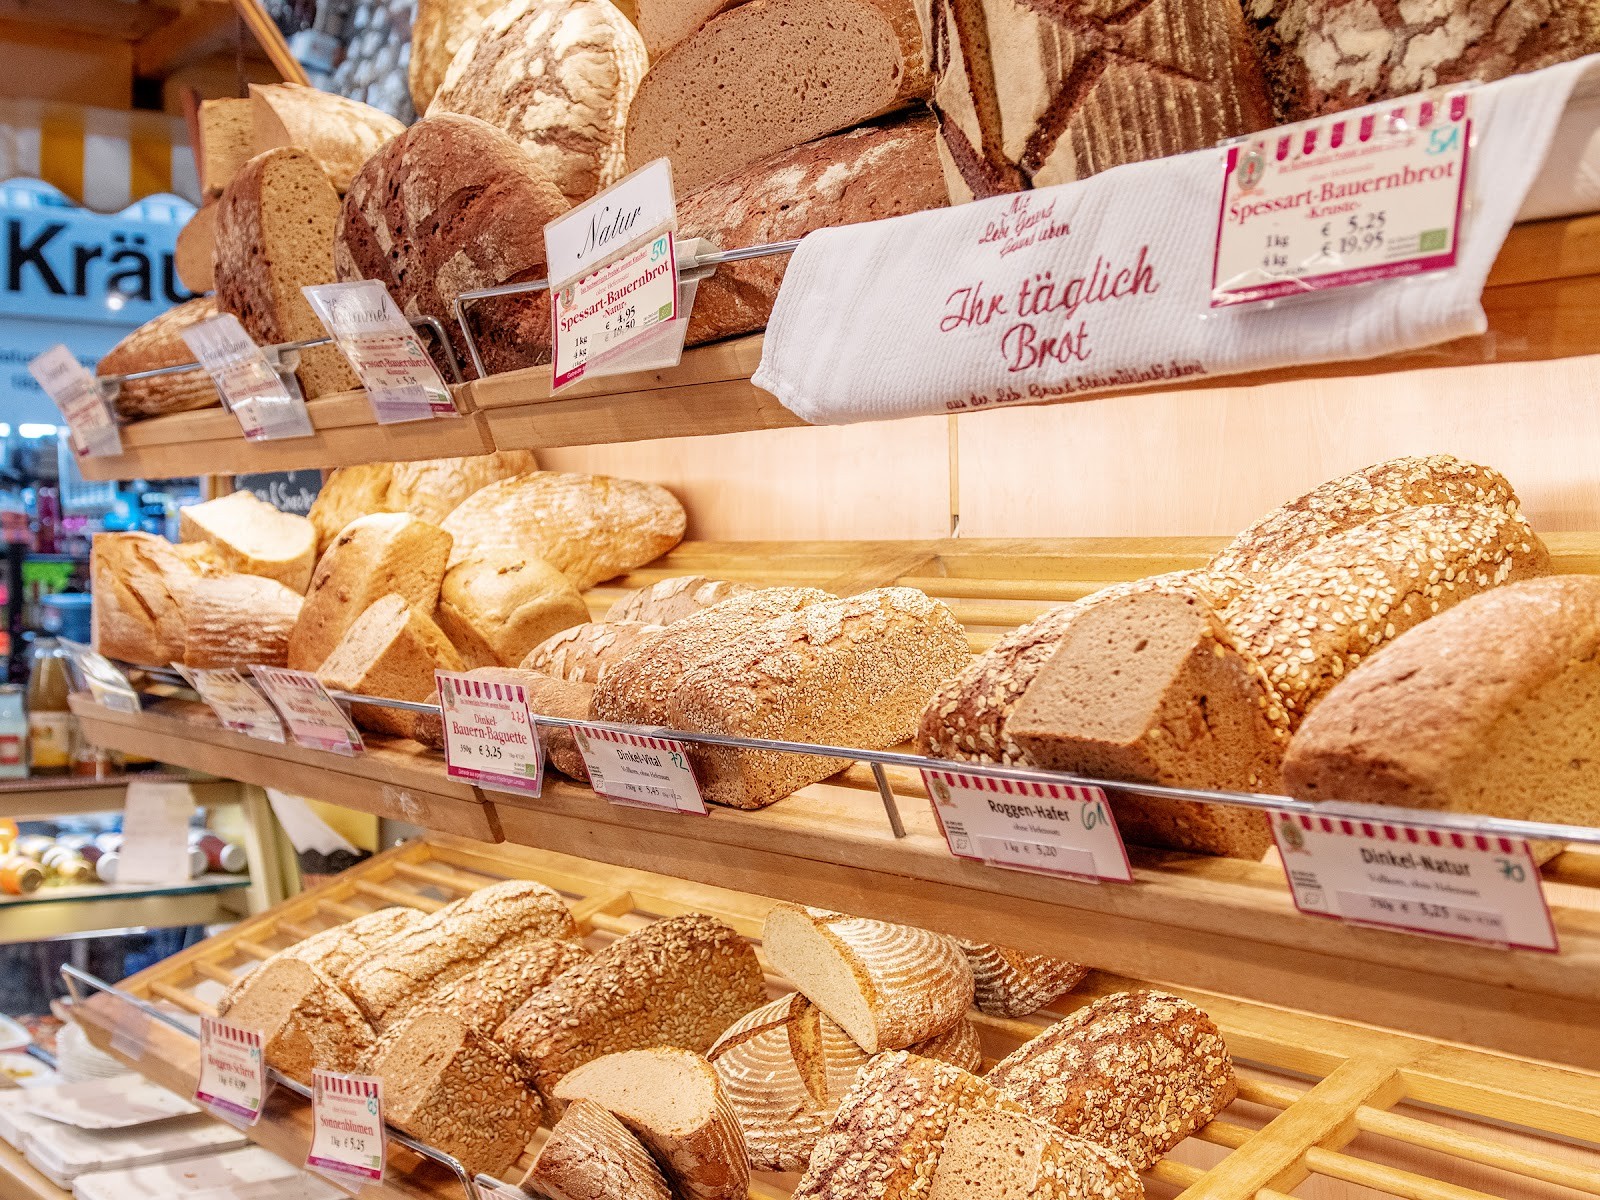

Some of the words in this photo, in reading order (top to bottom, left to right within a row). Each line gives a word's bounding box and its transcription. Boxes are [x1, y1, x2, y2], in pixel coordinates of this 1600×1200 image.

[1227, 160, 1455, 224] Spessart-Bauernbrot
[576, 205, 643, 260] Natur
[1320, 221, 1331, 237] €
[650, 236, 668, 263] 50
[560, 259, 670, 332] Spessart-Bauernbrot
[940, 280, 1007, 332] Ihr
[1018, 245, 1160, 320] täglich
[604, 321, 610, 330] €
[1001, 320, 1093, 373] Brot
[452, 721, 528, 745] Bauern-Baguette
[478, 745, 484, 756] €
[485, 744, 502, 760] 3,25
[616, 749, 662, 768] Dinkel-Vital
[987, 799, 1071, 822] Roggen-Hafer
[1358, 848, 1472, 878] Dinkel-Natur
[320, 1114, 374, 1137] Sonnenblumen
